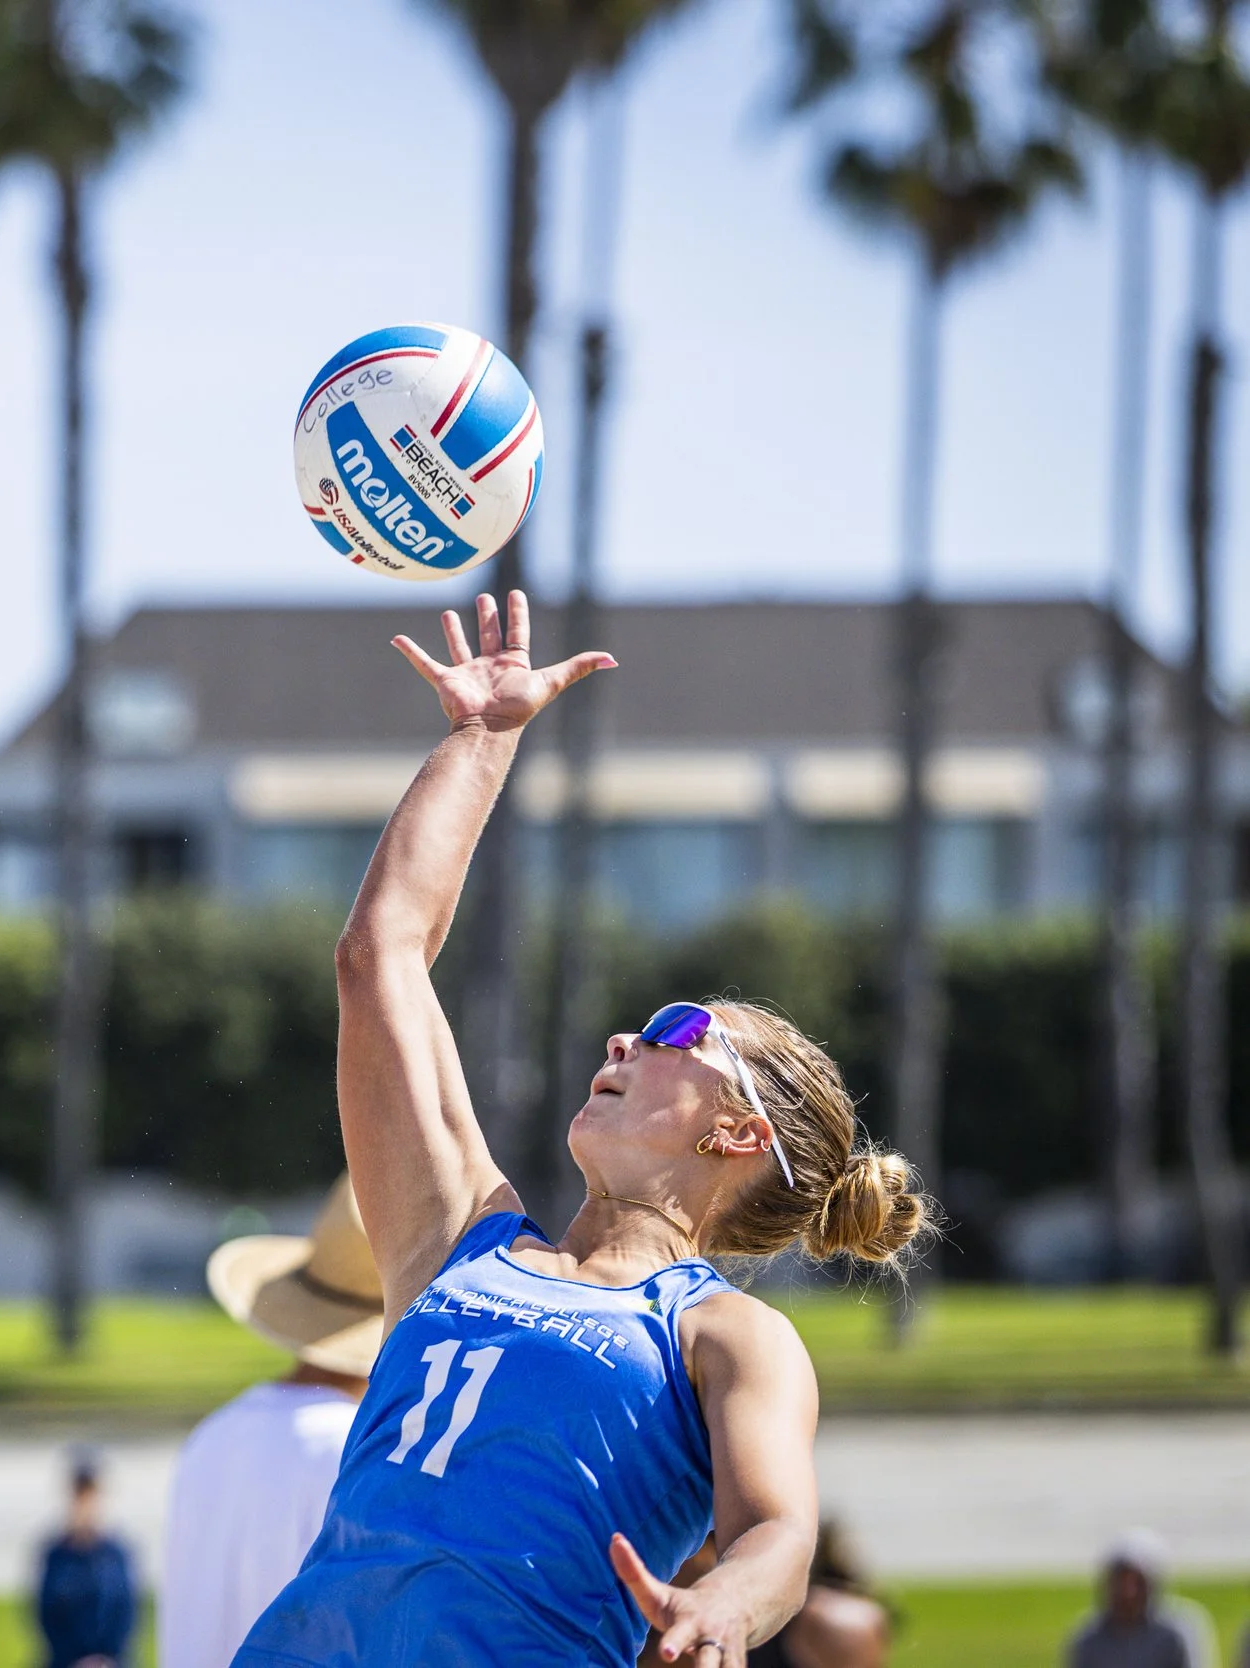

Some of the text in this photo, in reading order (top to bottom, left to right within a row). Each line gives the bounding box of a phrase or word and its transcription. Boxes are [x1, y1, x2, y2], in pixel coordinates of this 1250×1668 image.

[303, 369, 393, 433] College
[400, 451, 449, 508] VOLLEYBALL
[405, 442, 460, 504] BEACH
[416, 439, 435, 460] OFFICIAL
[336, 438, 446, 561] molten
[408, 474, 431, 499] BV5000
[400, 1296, 616, 1370] OLLEYBALL
[445, 1287, 525, 1308] MONICA
[530, 1302, 630, 1350] COLLEGE
[386, 1339, 505, 1478] 11
